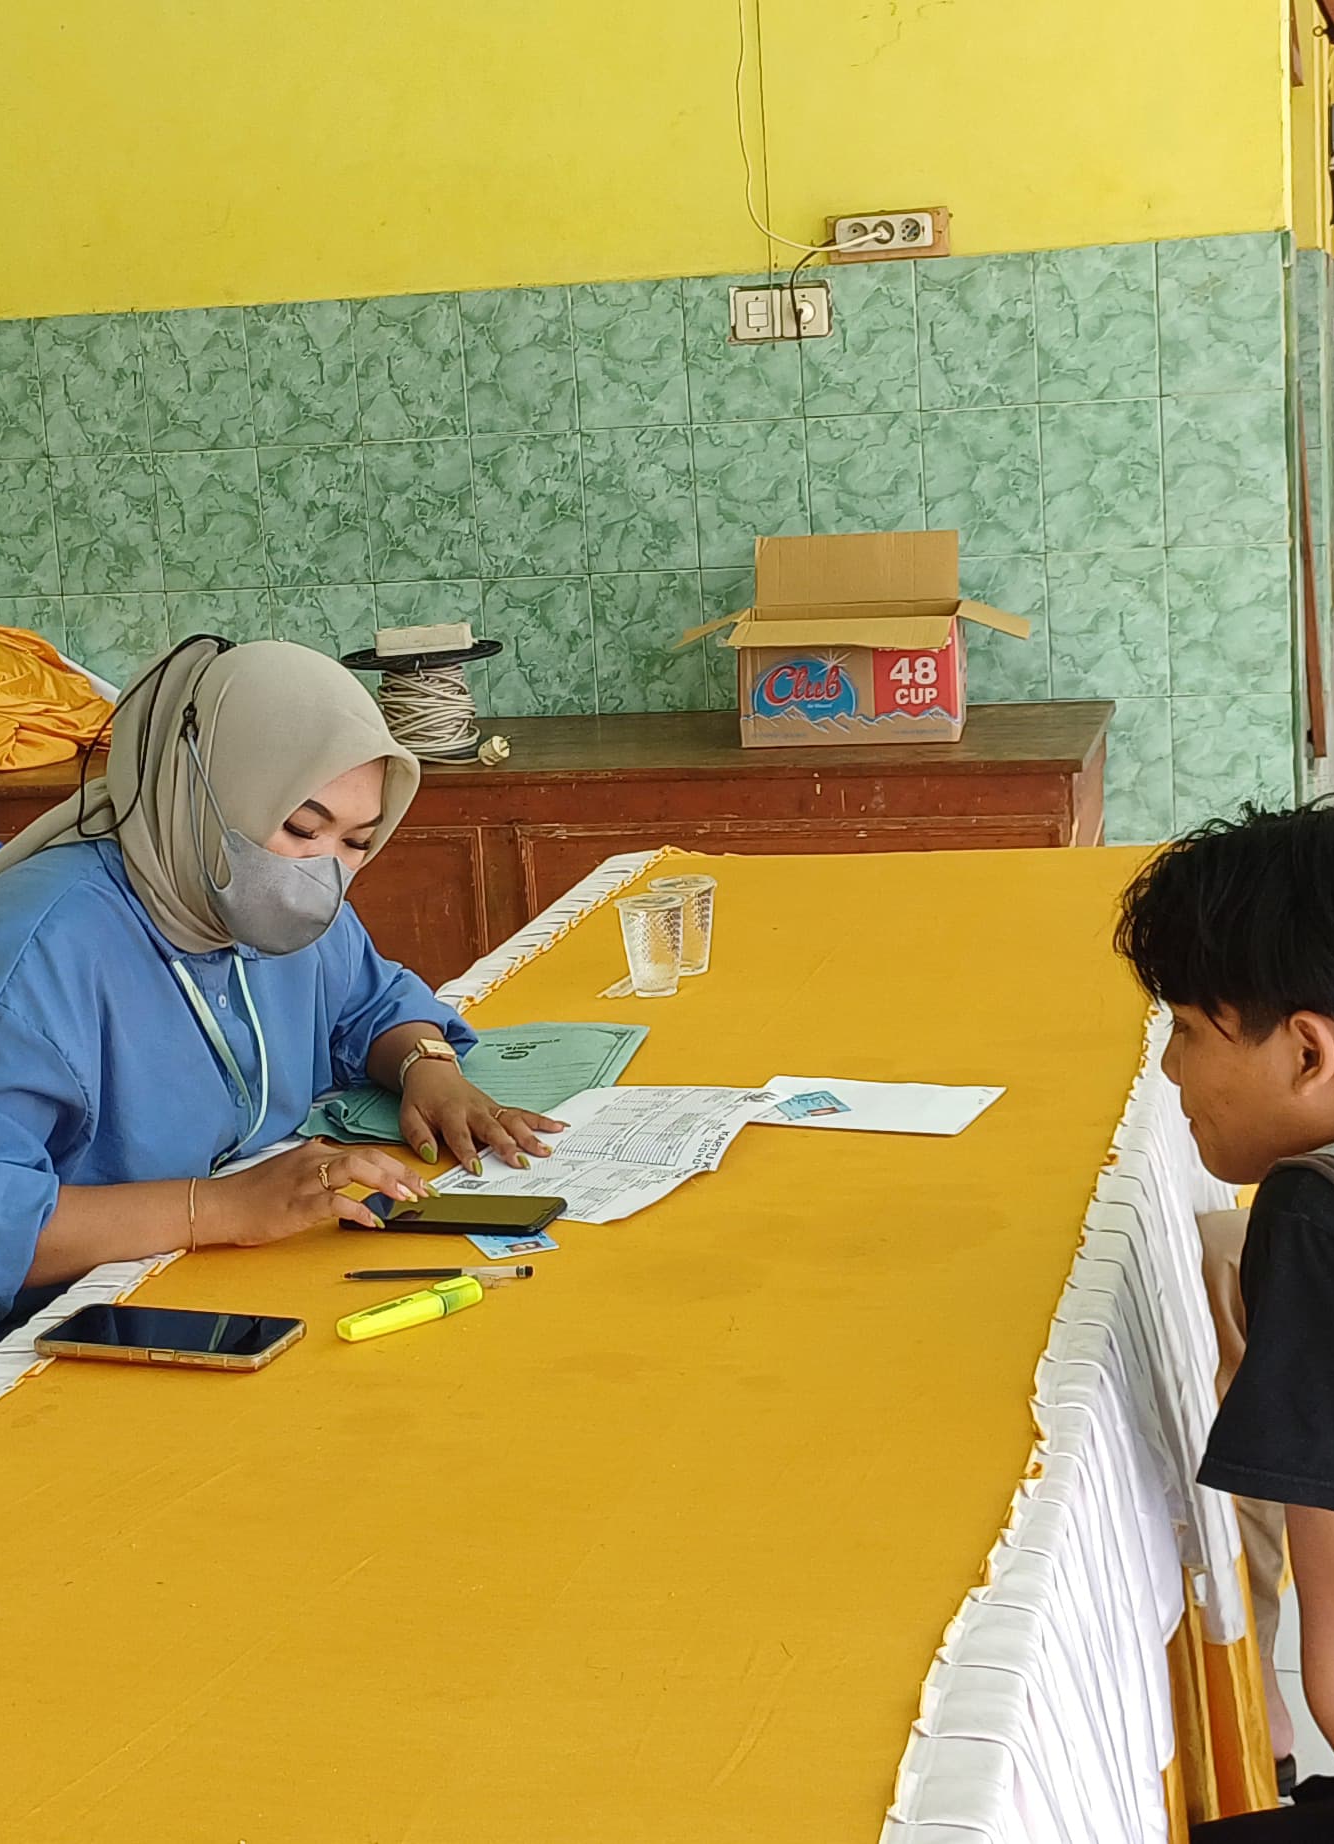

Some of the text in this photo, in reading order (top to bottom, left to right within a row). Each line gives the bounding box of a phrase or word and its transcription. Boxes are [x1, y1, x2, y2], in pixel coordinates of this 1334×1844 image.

[764, 665, 841, 705] Club
[889, 656, 938, 686] 48
[894, 686, 939, 705] CUP
